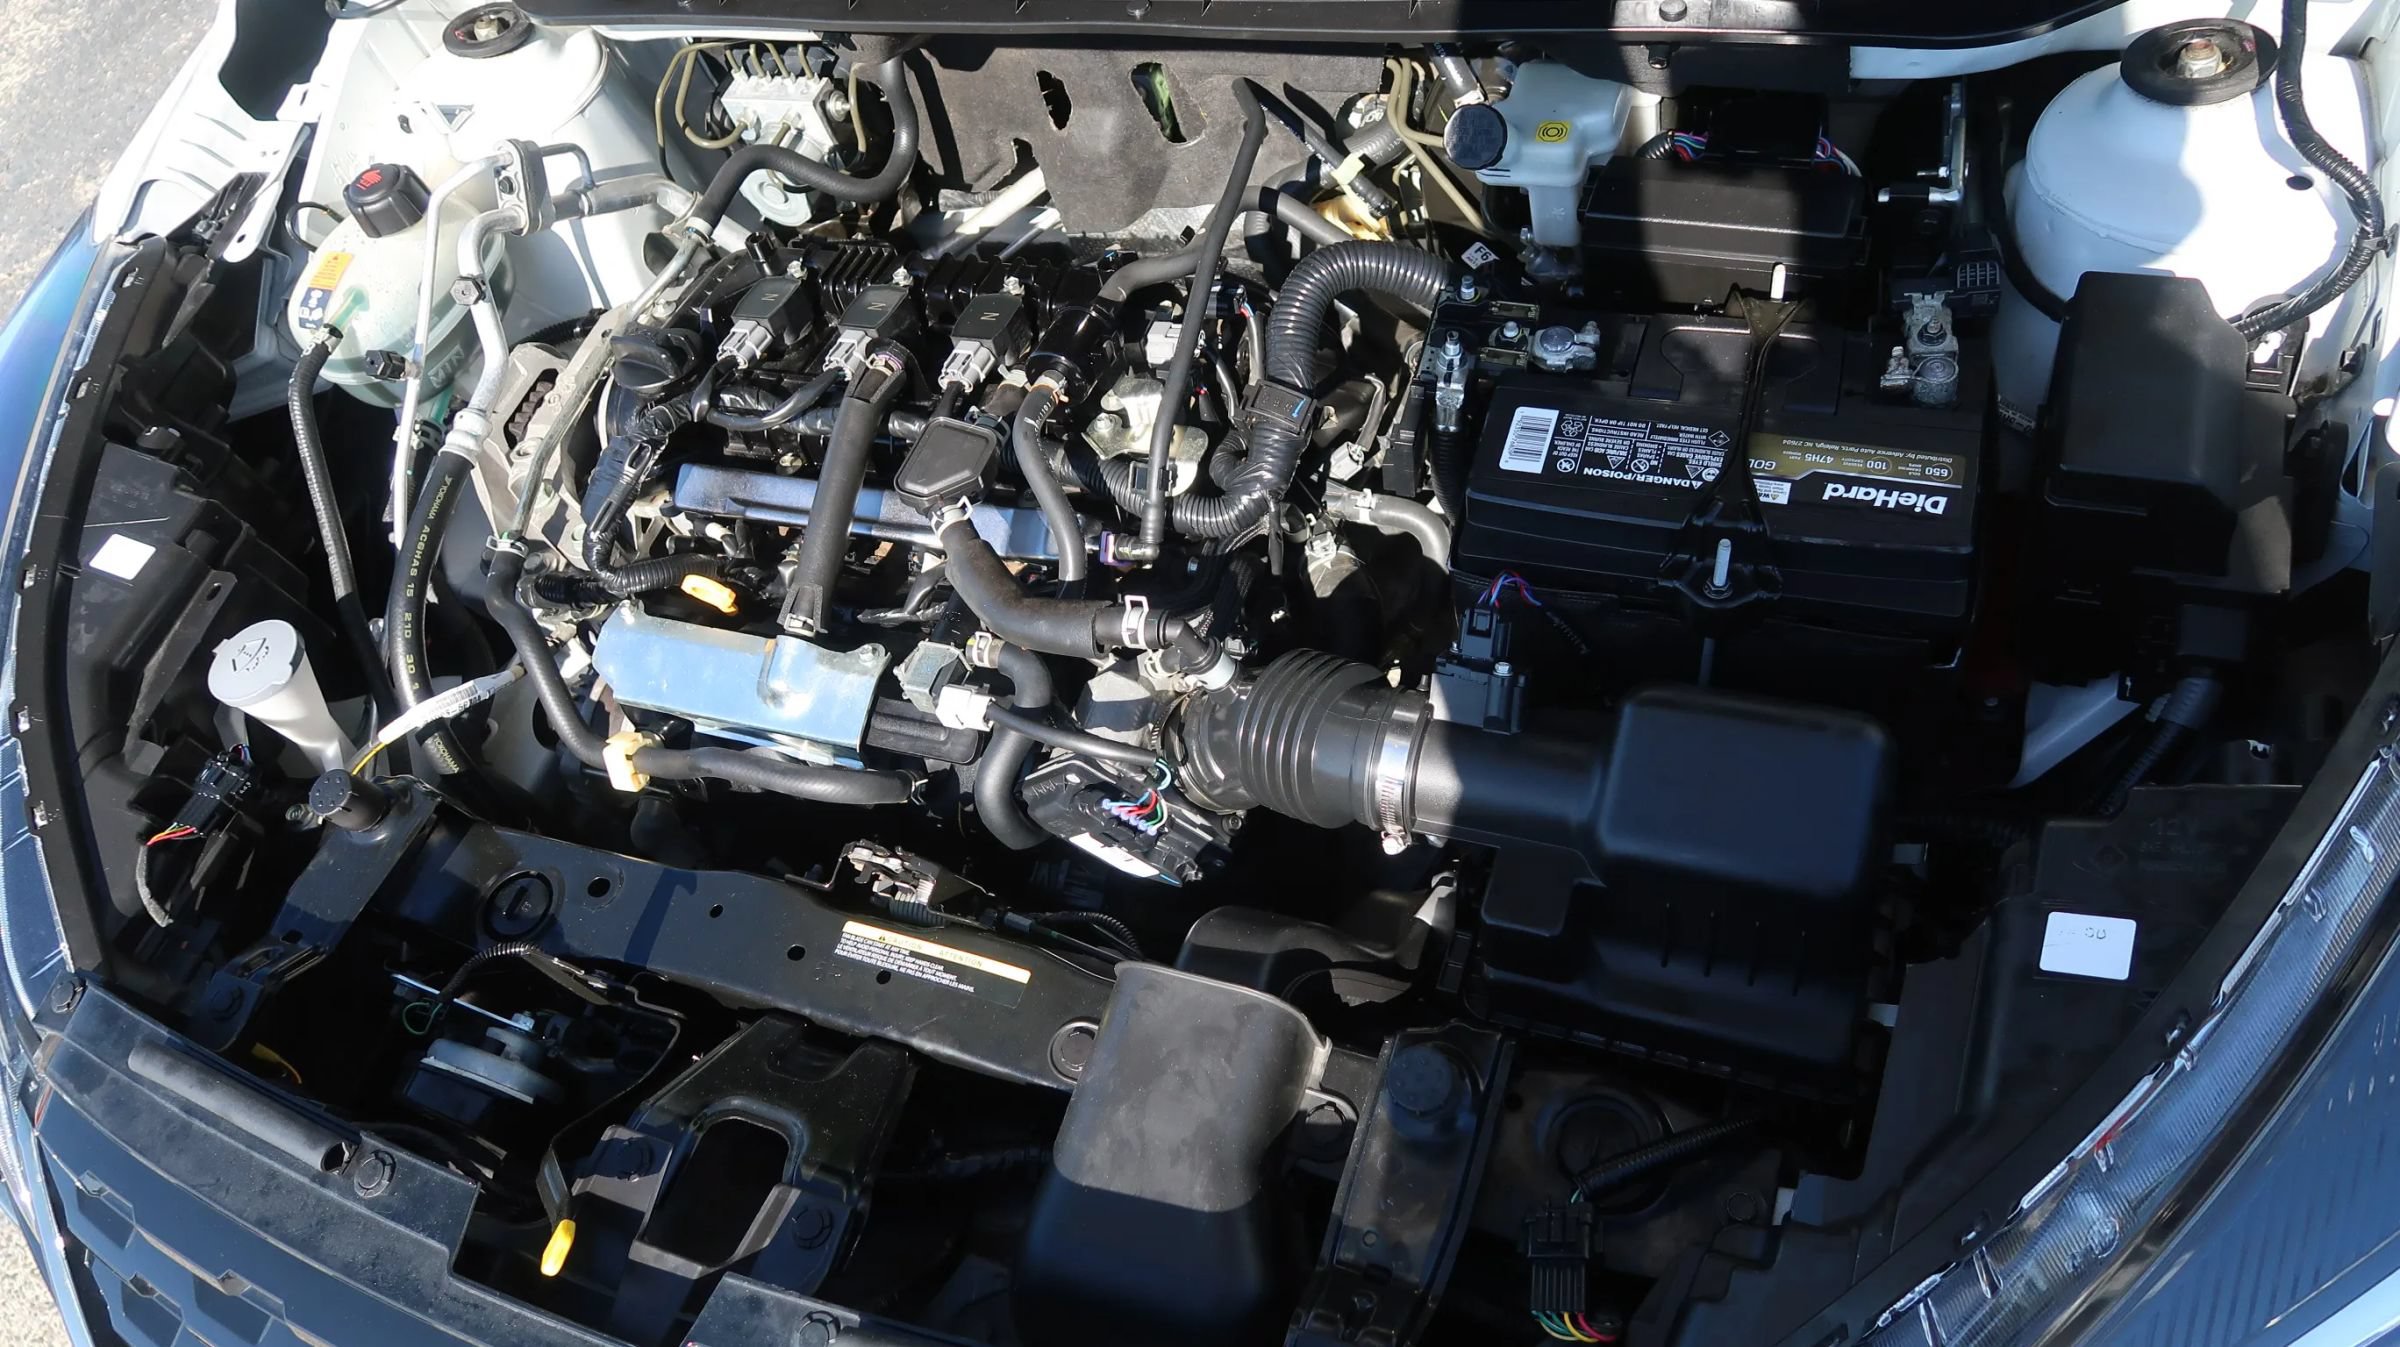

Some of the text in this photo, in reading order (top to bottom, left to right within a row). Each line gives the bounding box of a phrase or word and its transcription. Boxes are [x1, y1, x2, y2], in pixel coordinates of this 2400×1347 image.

[1475, 245, 1492, 261] F6
[1676, 451, 1694, 459] GASES
[1694, 453, 1724, 463] EXPLOSIVE
[1804, 453, 1834, 464] 47H5
[1876, 450, 1905, 458] Advance
[1916, 454, 1953, 464] Distributed
[1746, 457, 1776, 471] GOL
[1866, 460, 1887, 470] 100
[1583, 467, 1691, 488] DANGER/POISON
[1925, 467, 1948, 477] 650
[428, 483, 452, 520] YOKOHAMA
[1822, 482, 1948, 515] DieHard
[406, 583, 415, 599] 15
[433, 735, 460, 774] YOKOHAMA
